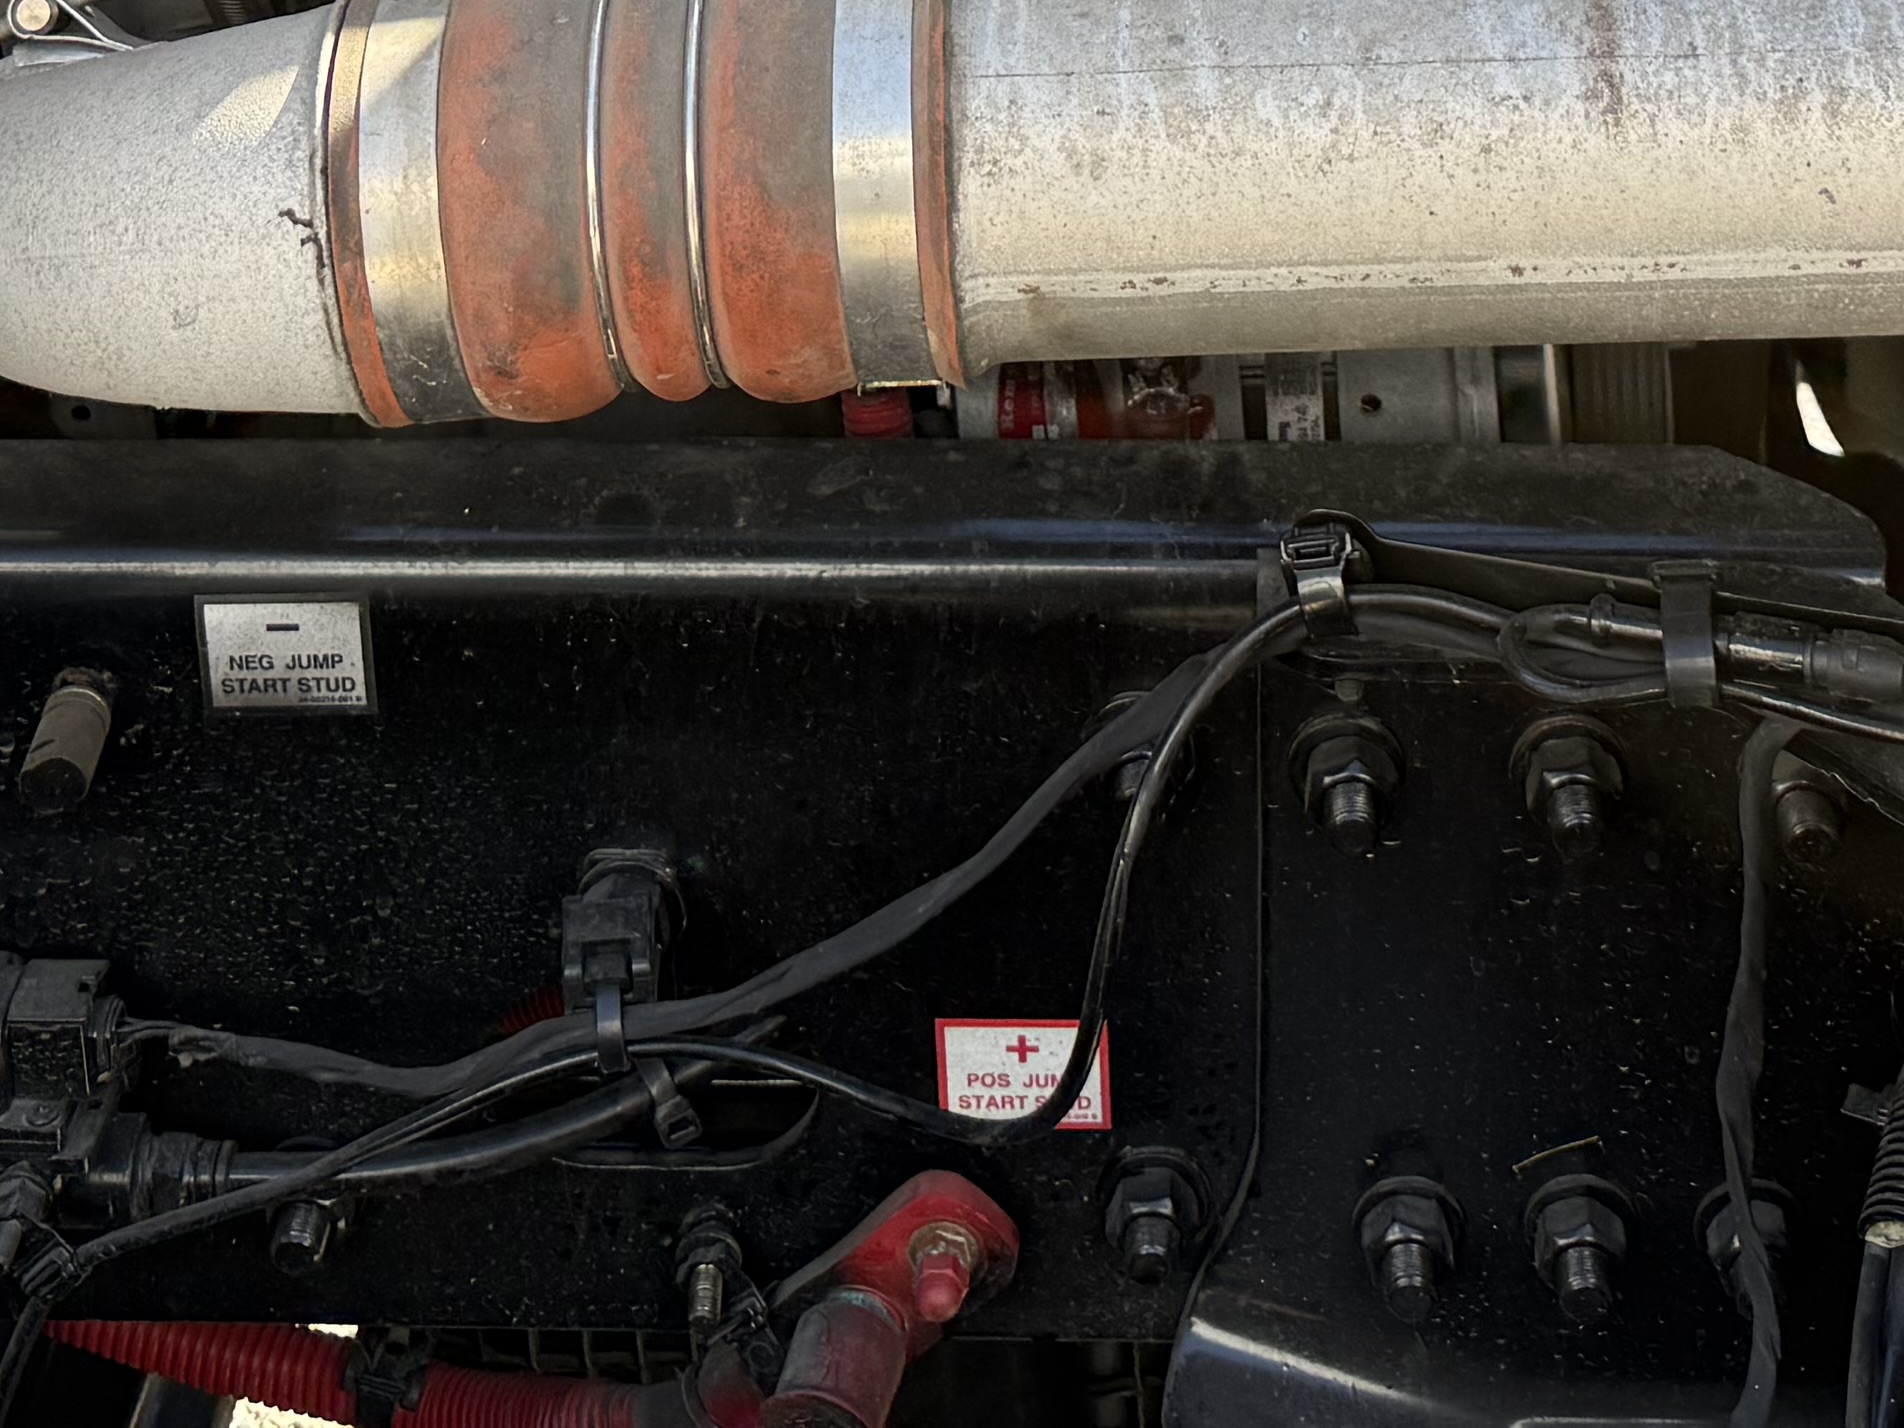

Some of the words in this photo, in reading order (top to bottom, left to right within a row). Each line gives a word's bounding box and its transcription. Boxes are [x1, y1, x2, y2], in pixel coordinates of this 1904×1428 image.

[229, 654, 274, 671] NEG
[286, 653, 343, 670] JUMP
[222, 678, 291, 694] START
[298, 676, 356, 693] STUD
[967, 1072, 1011, 1088] POS
[958, 1095, 1028, 1110] START
[1035, 1095, 1092, 1110] SD
